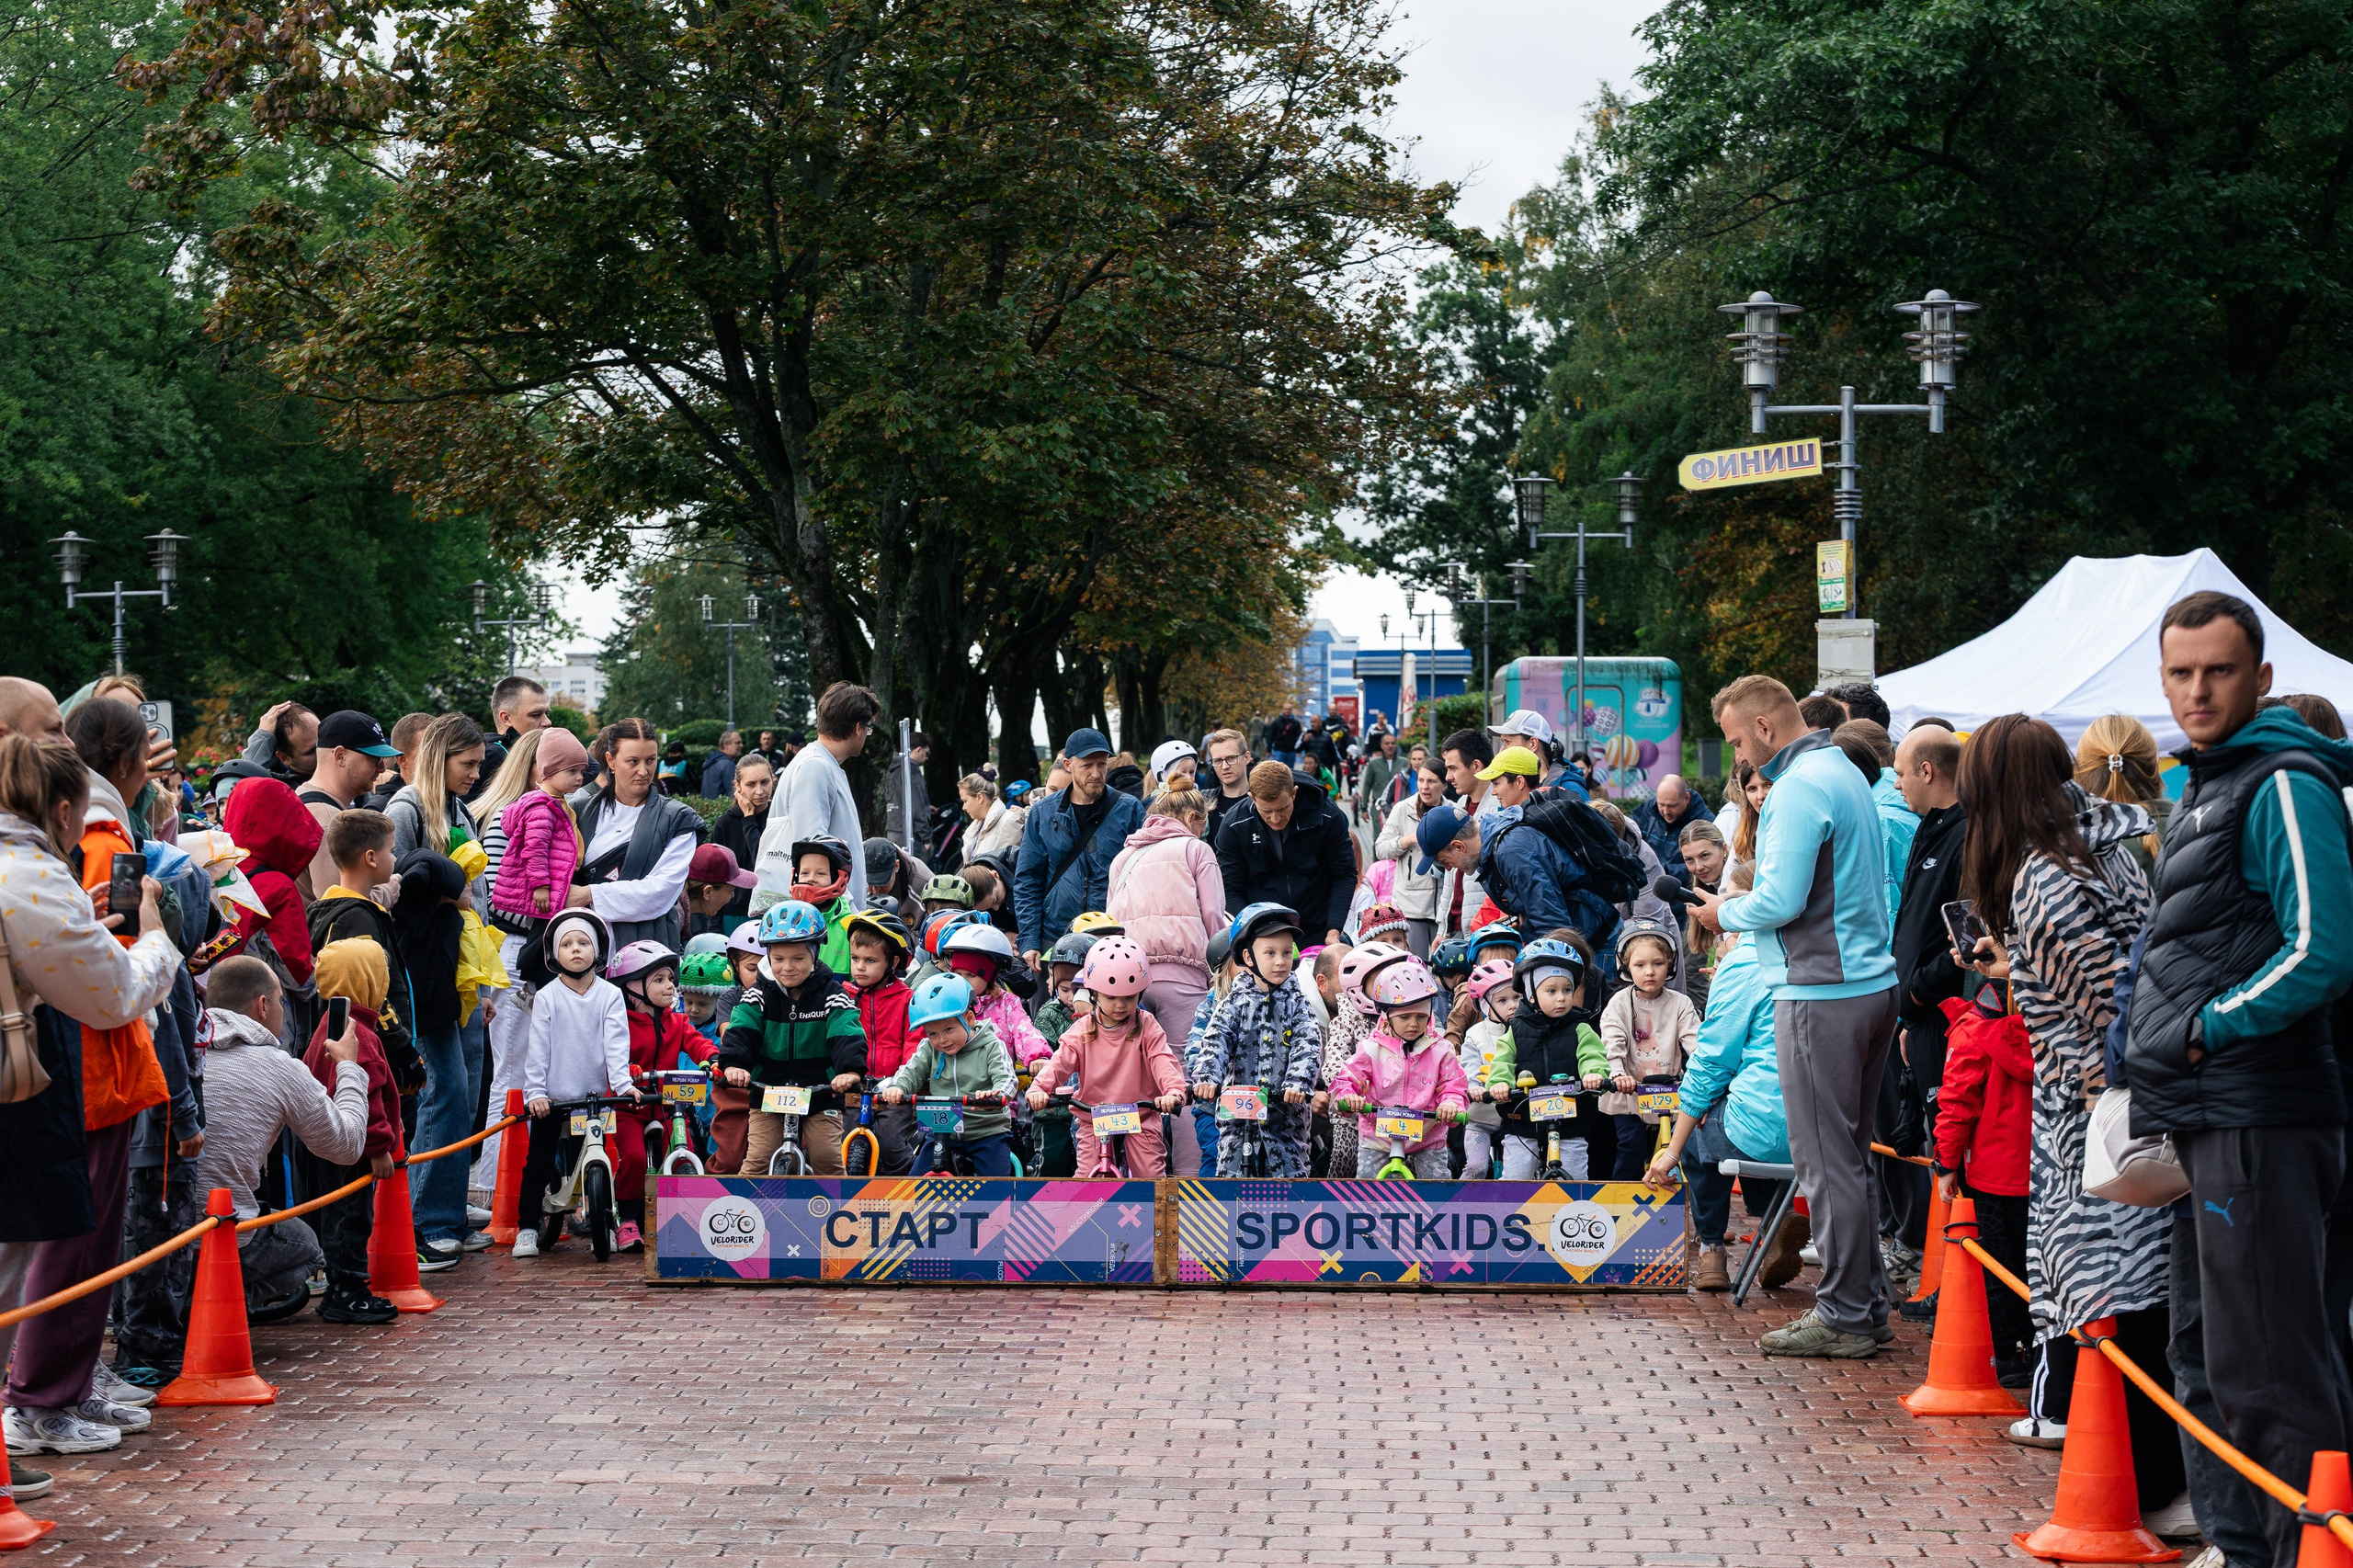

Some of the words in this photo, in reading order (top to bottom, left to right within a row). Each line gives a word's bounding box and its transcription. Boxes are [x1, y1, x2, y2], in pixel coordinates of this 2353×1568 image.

[1691, 443, 1816, 483] ФИНИШ
[679, 1085, 695, 1096] 59
[777, 1096, 797, 1106] 112
[1235, 1097, 1254, 1110] 96
[1547, 1098, 1564, 1110] 20
[1653, 1096, 1672, 1106] 179
[932, 1112, 949, 1125] 18
[1110, 1115, 1129, 1126] 43
[1398, 1120, 1406, 1131] 4
[1068, 1197, 1104, 1233] #ДОСТИЖЕНИЯ
[826, 1210, 989, 1248] СТАРТ
